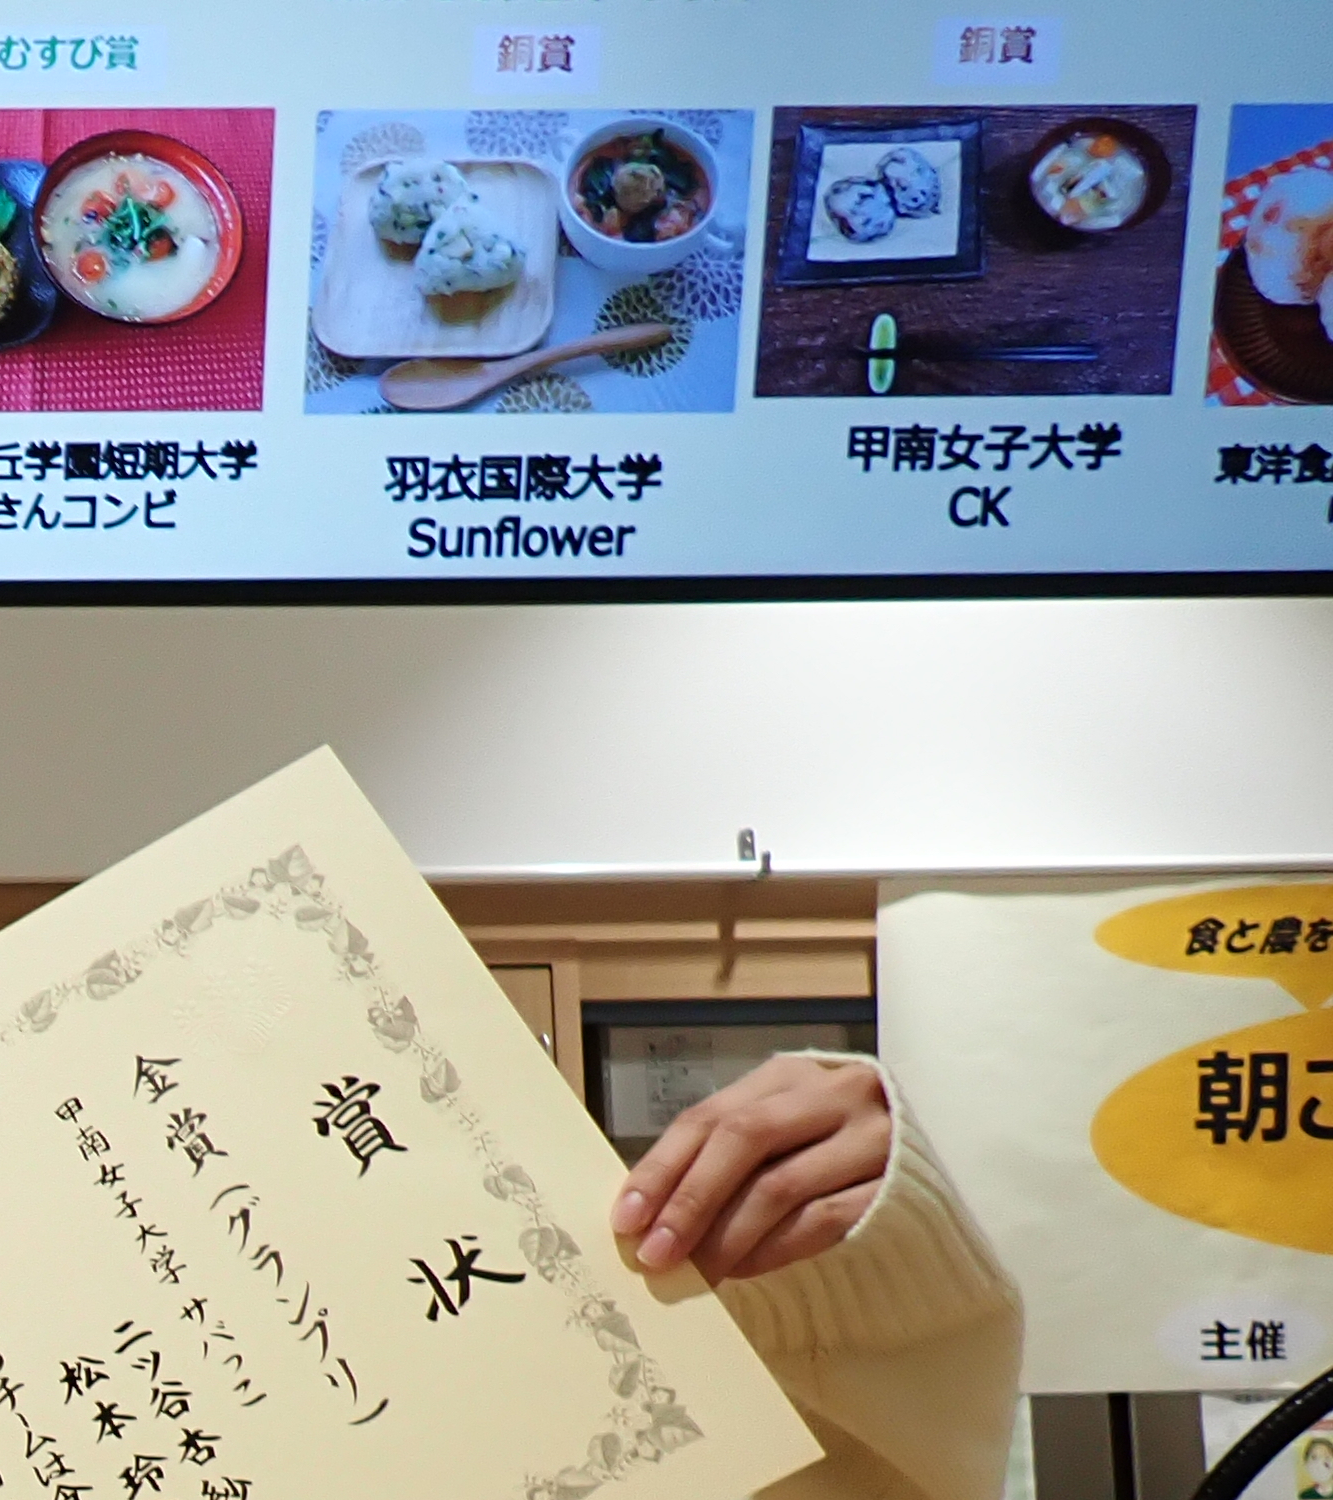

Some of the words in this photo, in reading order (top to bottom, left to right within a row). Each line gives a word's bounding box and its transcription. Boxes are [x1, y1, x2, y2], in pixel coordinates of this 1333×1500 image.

[497, 33, 577, 74] 銅賞
[958, 24, 1038, 65] 銅賞
[846, 421, 1123, 473] 甲南女子大学
[384, 452, 663, 503] 羽衣国際大学
[948, 485, 1013, 529] CK
[407, 515, 637, 559] Sunflower
[53, 1096, 187, 1284] 甲南女子大学
[311, 1074, 527, 1323] 賞状
[1200, 1319, 1287, 1363] 主催
